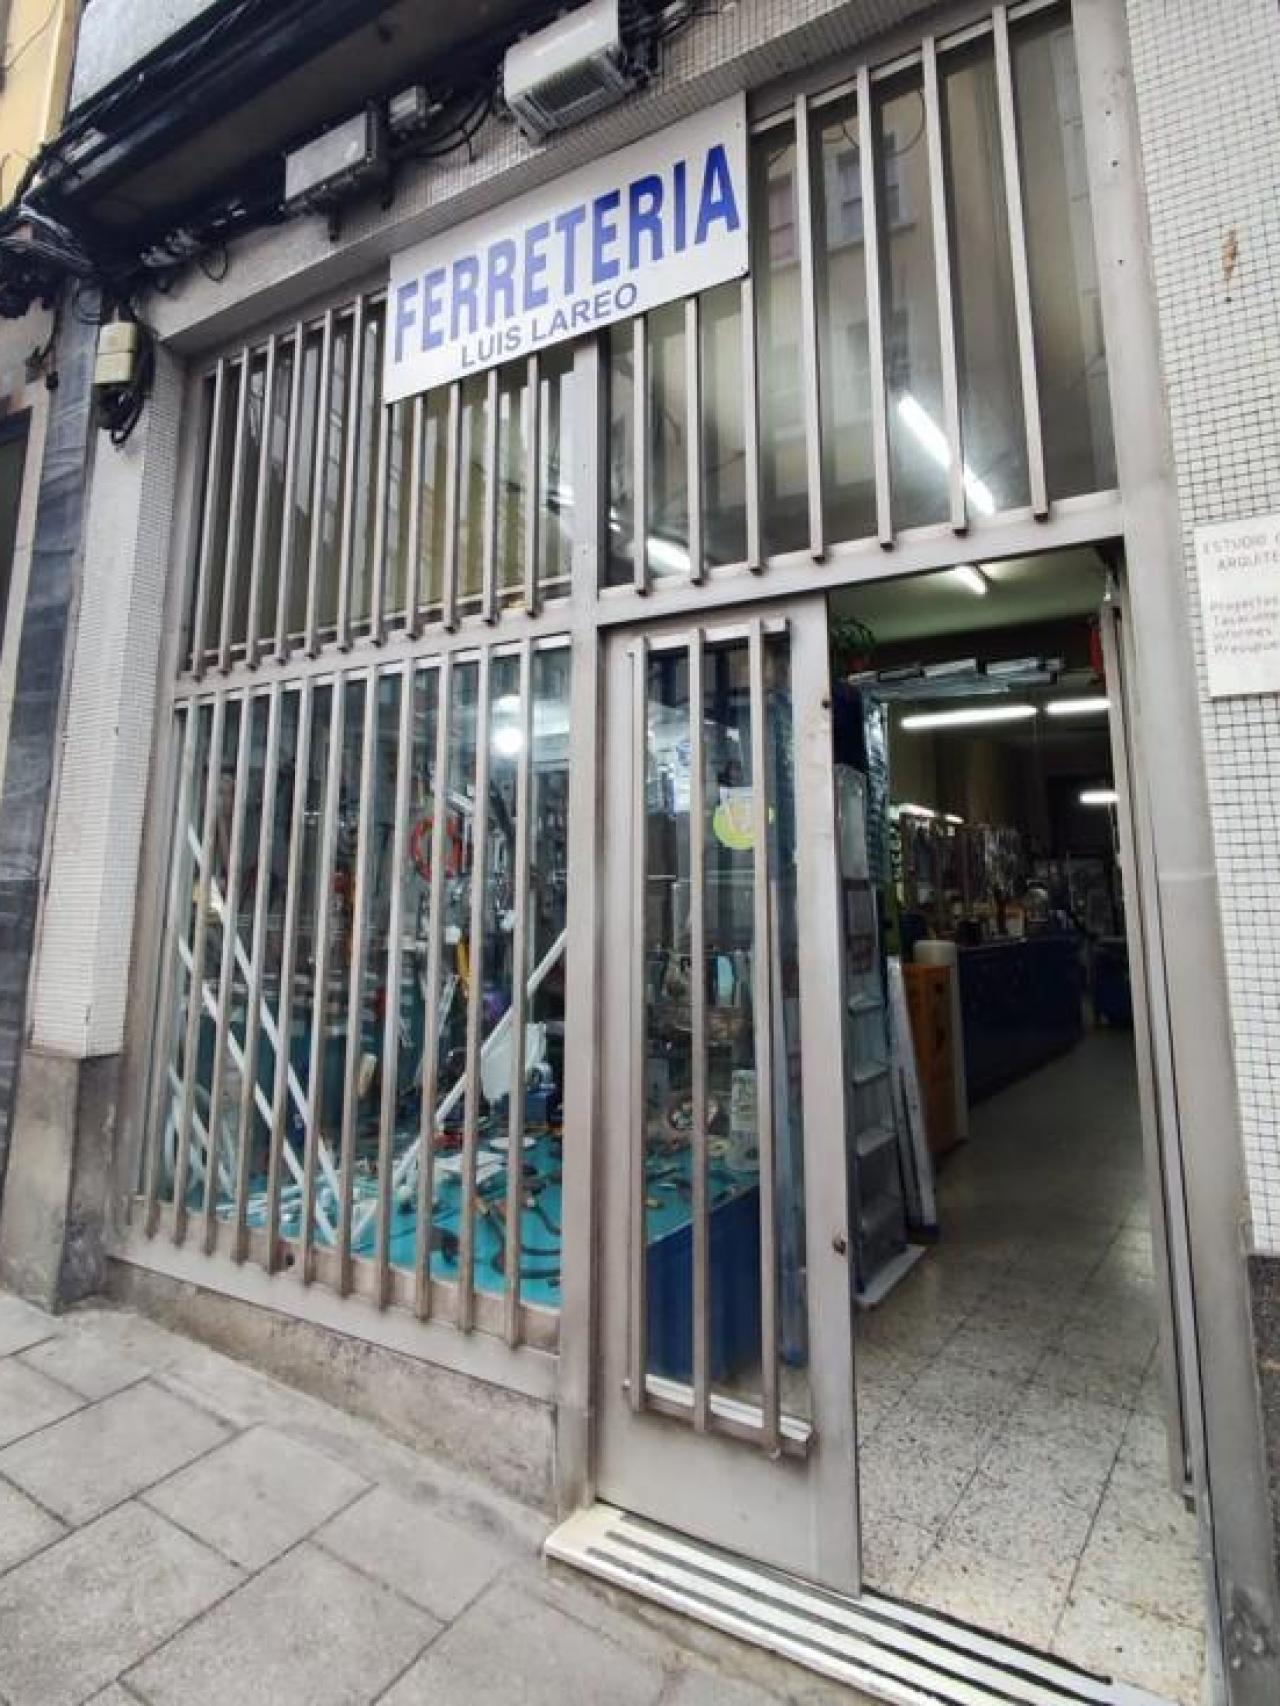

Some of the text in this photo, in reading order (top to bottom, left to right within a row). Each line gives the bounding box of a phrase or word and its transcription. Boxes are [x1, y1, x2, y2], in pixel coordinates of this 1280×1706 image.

[394, 144, 740, 363] FERRETERIA
[461, 282, 638, 369] LUIS LAREO
